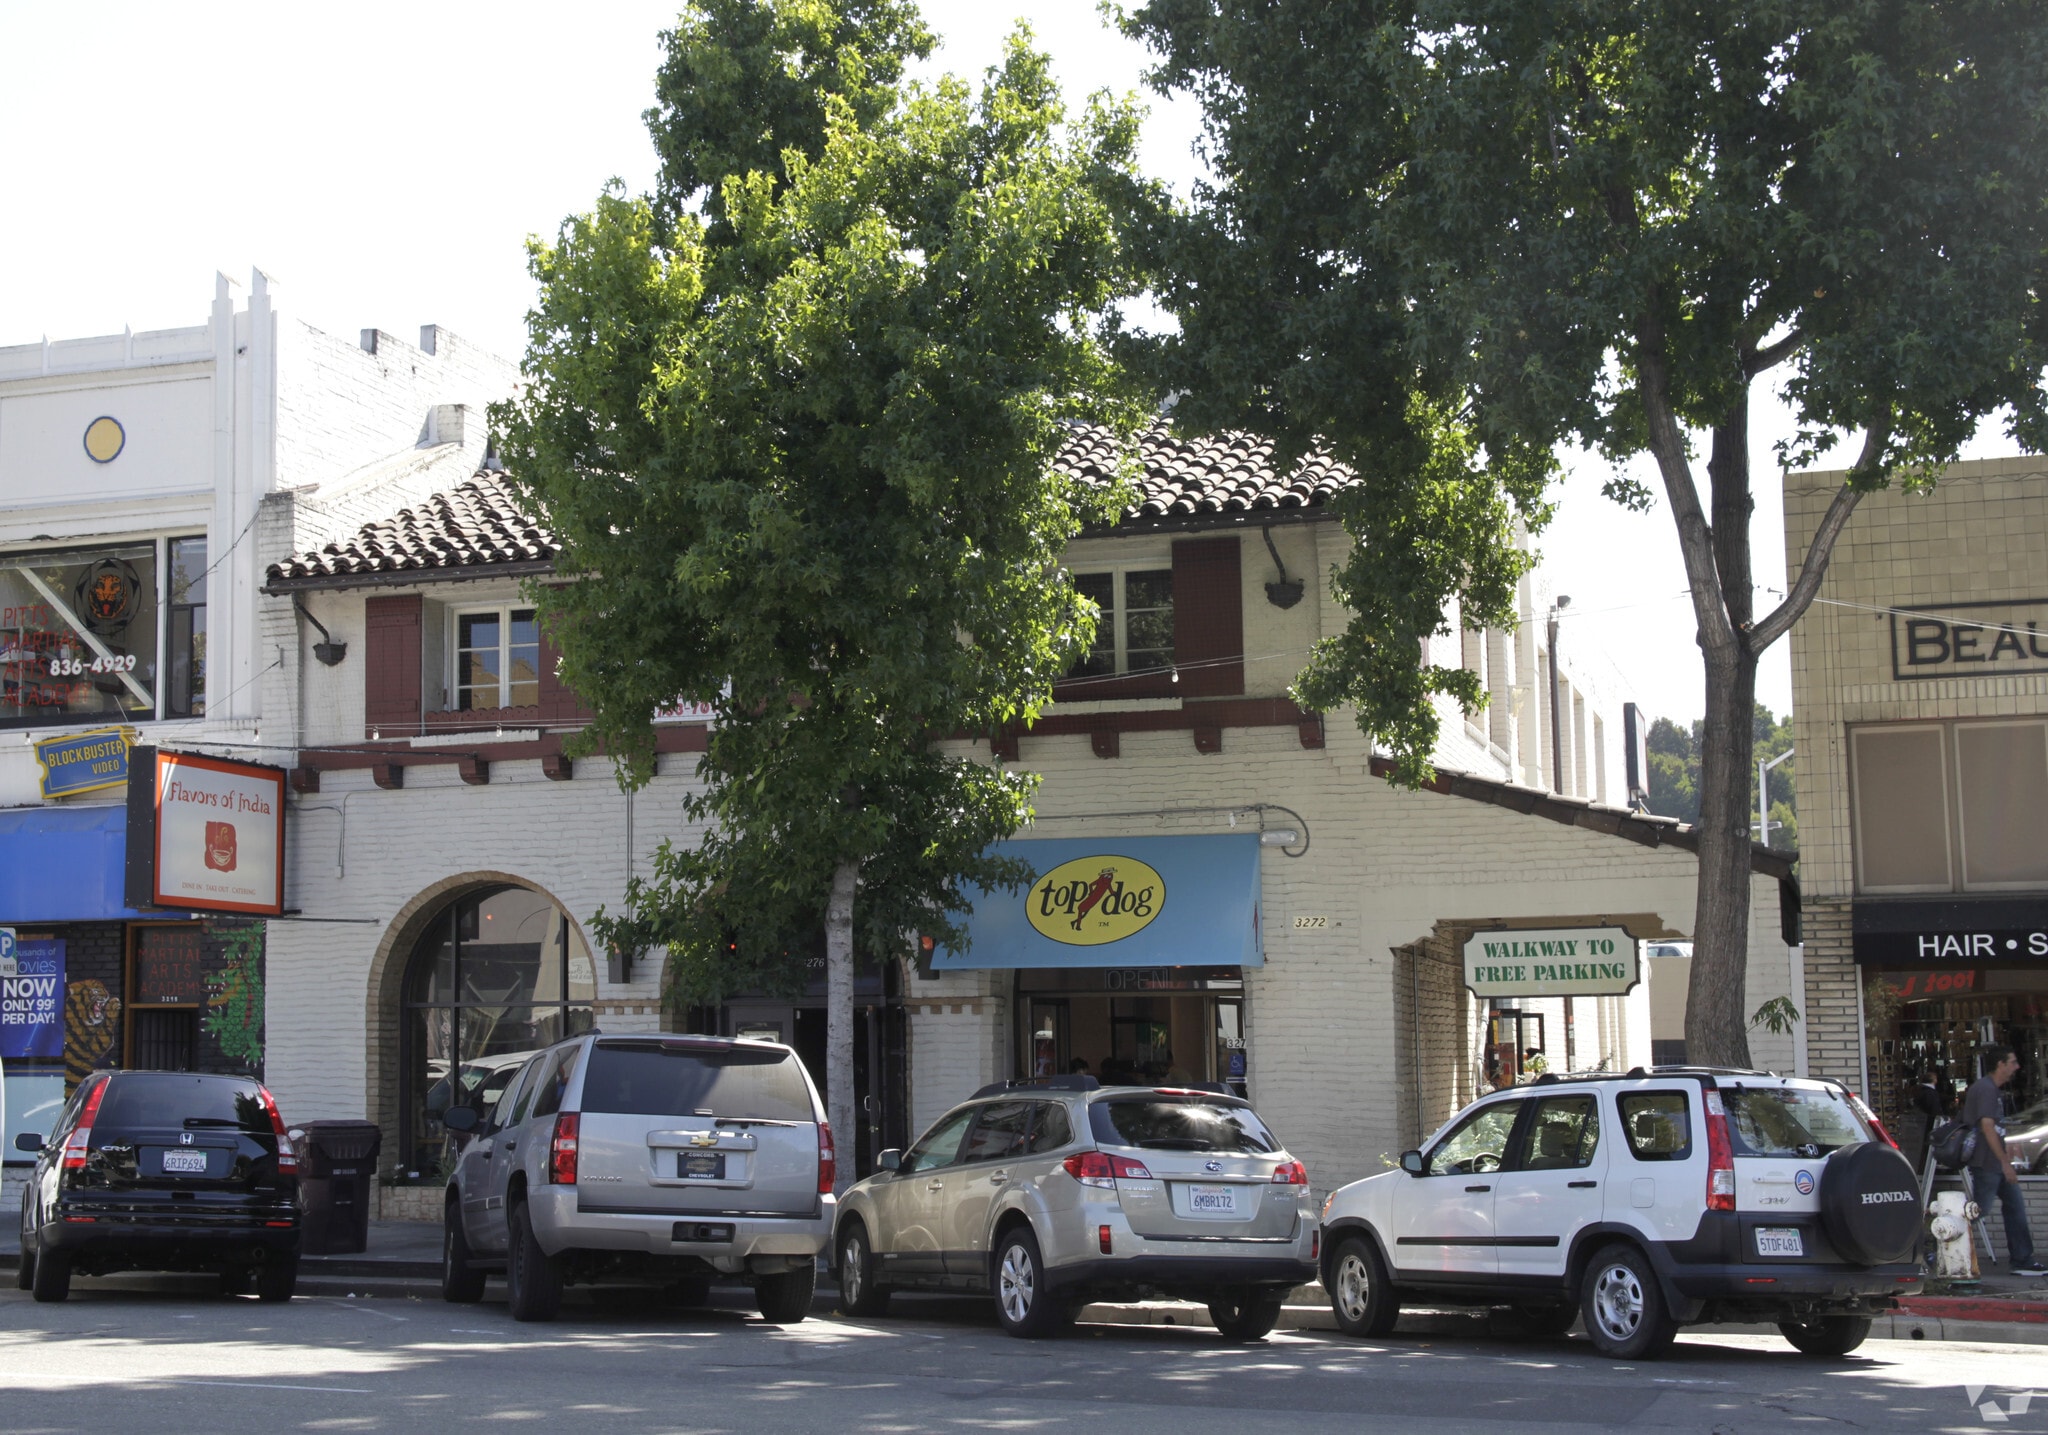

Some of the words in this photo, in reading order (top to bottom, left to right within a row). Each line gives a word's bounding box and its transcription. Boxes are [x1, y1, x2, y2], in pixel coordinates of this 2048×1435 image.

[3, 630, 80, 655] MARTIAL
[2, 659, 47, 680] ARTS
[50, 655, 136, 677] 836-4929
[2, 682, 92, 707] ACADEMY
[48, 740, 124, 767] BLOCKBUSTER
[92, 759, 119, 774] VIDEO
[168, 781, 218, 807] Flavors
[221, 790, 235, 809] of
[238, 792, 271, 815] India
[232, 887, 256, 895] CATERING
[1040, 880, 1089, 916] top
[1101, 881, 1154, 917] dog
[1295, 917, 1326, 928] 3272
[16, 948, 45, 957] ousands
[48, 947, 56, 955] of
[1483, 940, 1579, 958] WALKWAY
[1587, 939, 1614, 955] TO
[1918, 934, 1996, 957] HAIR
[138, 947, 201, 962] MARTIAL
[18, 957, 56, 973] ovies
[804, 957, 825, 968] 276
[149, 963, 192, 978] ARTS
[1475, 965, 1526, 982] FREE
[1533, 963, 1625, 981] PARKING
[1107, 970, 1165, 990] OPEN
[3, 978, 56, 998] NOW
[2, 999, 35, 1012] ONLY
[2, 1013, 25, 1025] PER
[28, 1012, 55, 1024] DAY!
[165, 1157, 204, 1170] 6RIP694
[1194, 1195, 1232, 1208] 6MBR172
[1861, 1191, 1913, 1204] HONDA
[1760, 1238, 1800, 1251] 5TDF481
